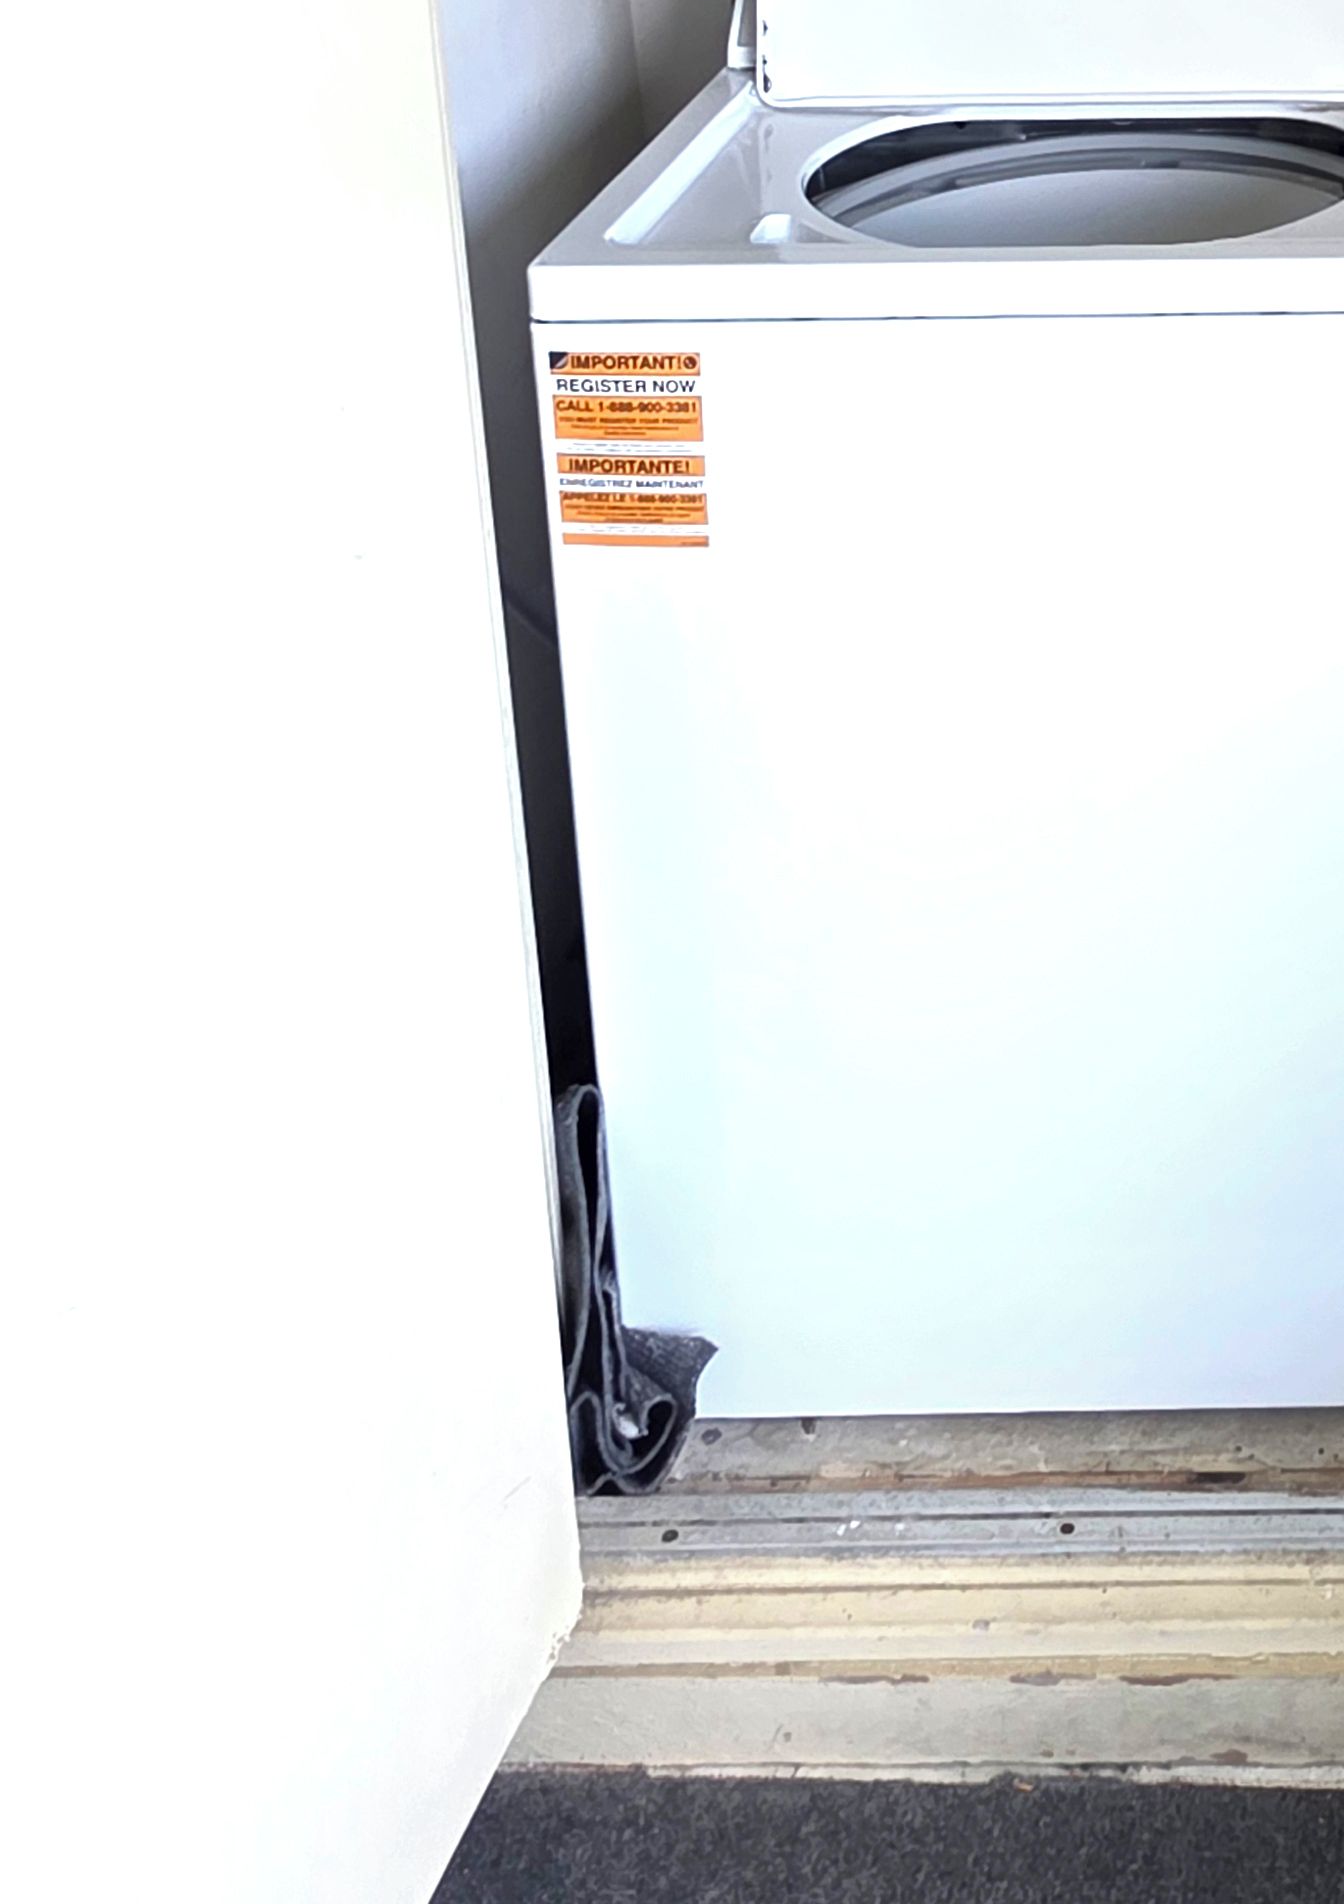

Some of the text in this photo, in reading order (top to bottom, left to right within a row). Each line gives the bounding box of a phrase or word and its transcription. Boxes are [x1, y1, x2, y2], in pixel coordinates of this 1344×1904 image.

[571, 355, 682, 370] IMPORTANT!
[556, 378, 696, 393] REGISTER NOW
[556, 399, 594, 412] CALL
[568, 458, 690, 475] IMPORTANTE!
